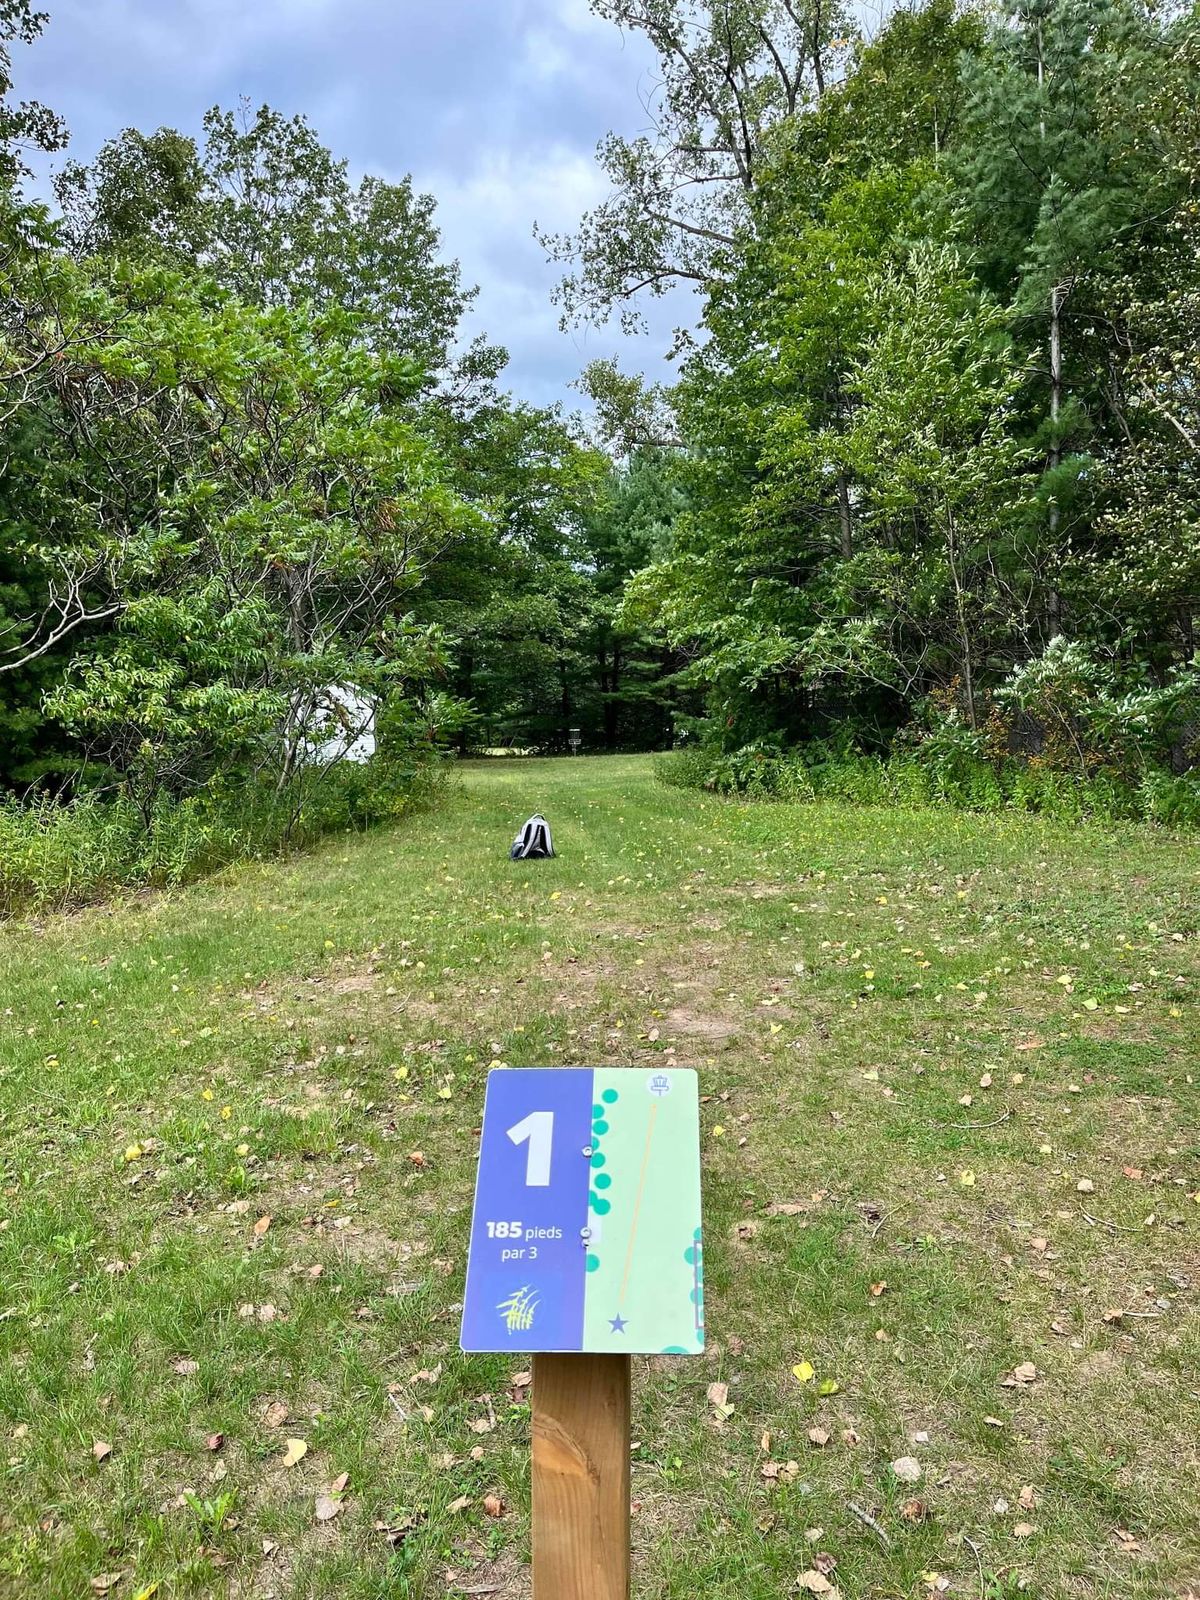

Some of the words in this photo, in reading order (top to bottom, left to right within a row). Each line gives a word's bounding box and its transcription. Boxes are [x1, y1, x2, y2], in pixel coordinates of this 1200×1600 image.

[506, 1111, 554, 1186] 1
[486, 1221, 523, 1239] 185
[525, 1225, 562, 1241] pieds
[501, 1249, 525, 1262] par
[528, 1247, 537, 1259] 3
